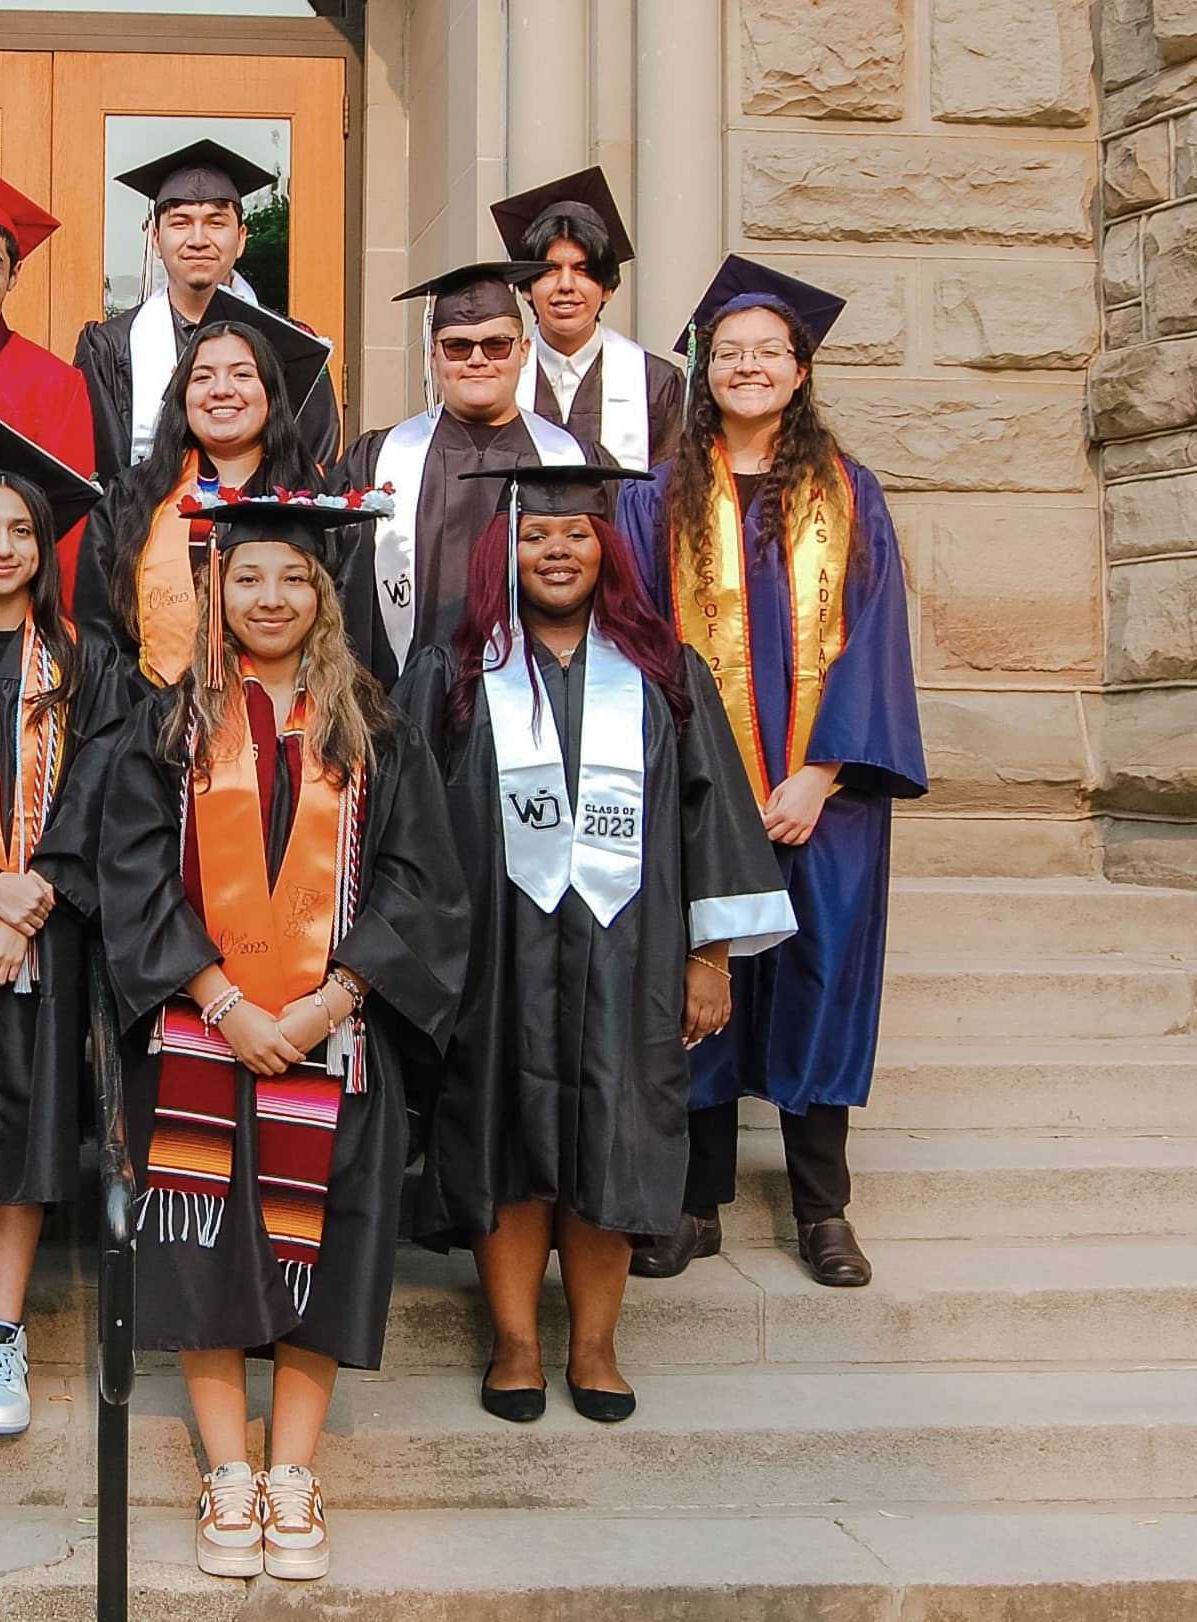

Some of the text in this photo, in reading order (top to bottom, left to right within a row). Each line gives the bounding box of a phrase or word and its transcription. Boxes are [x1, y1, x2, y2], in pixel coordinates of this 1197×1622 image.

[704, 603, 719, 638] OF
[584, 803, 636, 816] CLASS OF
[584, 815, 635, 838] 2023
[239, 941, 269, 955] 2023
